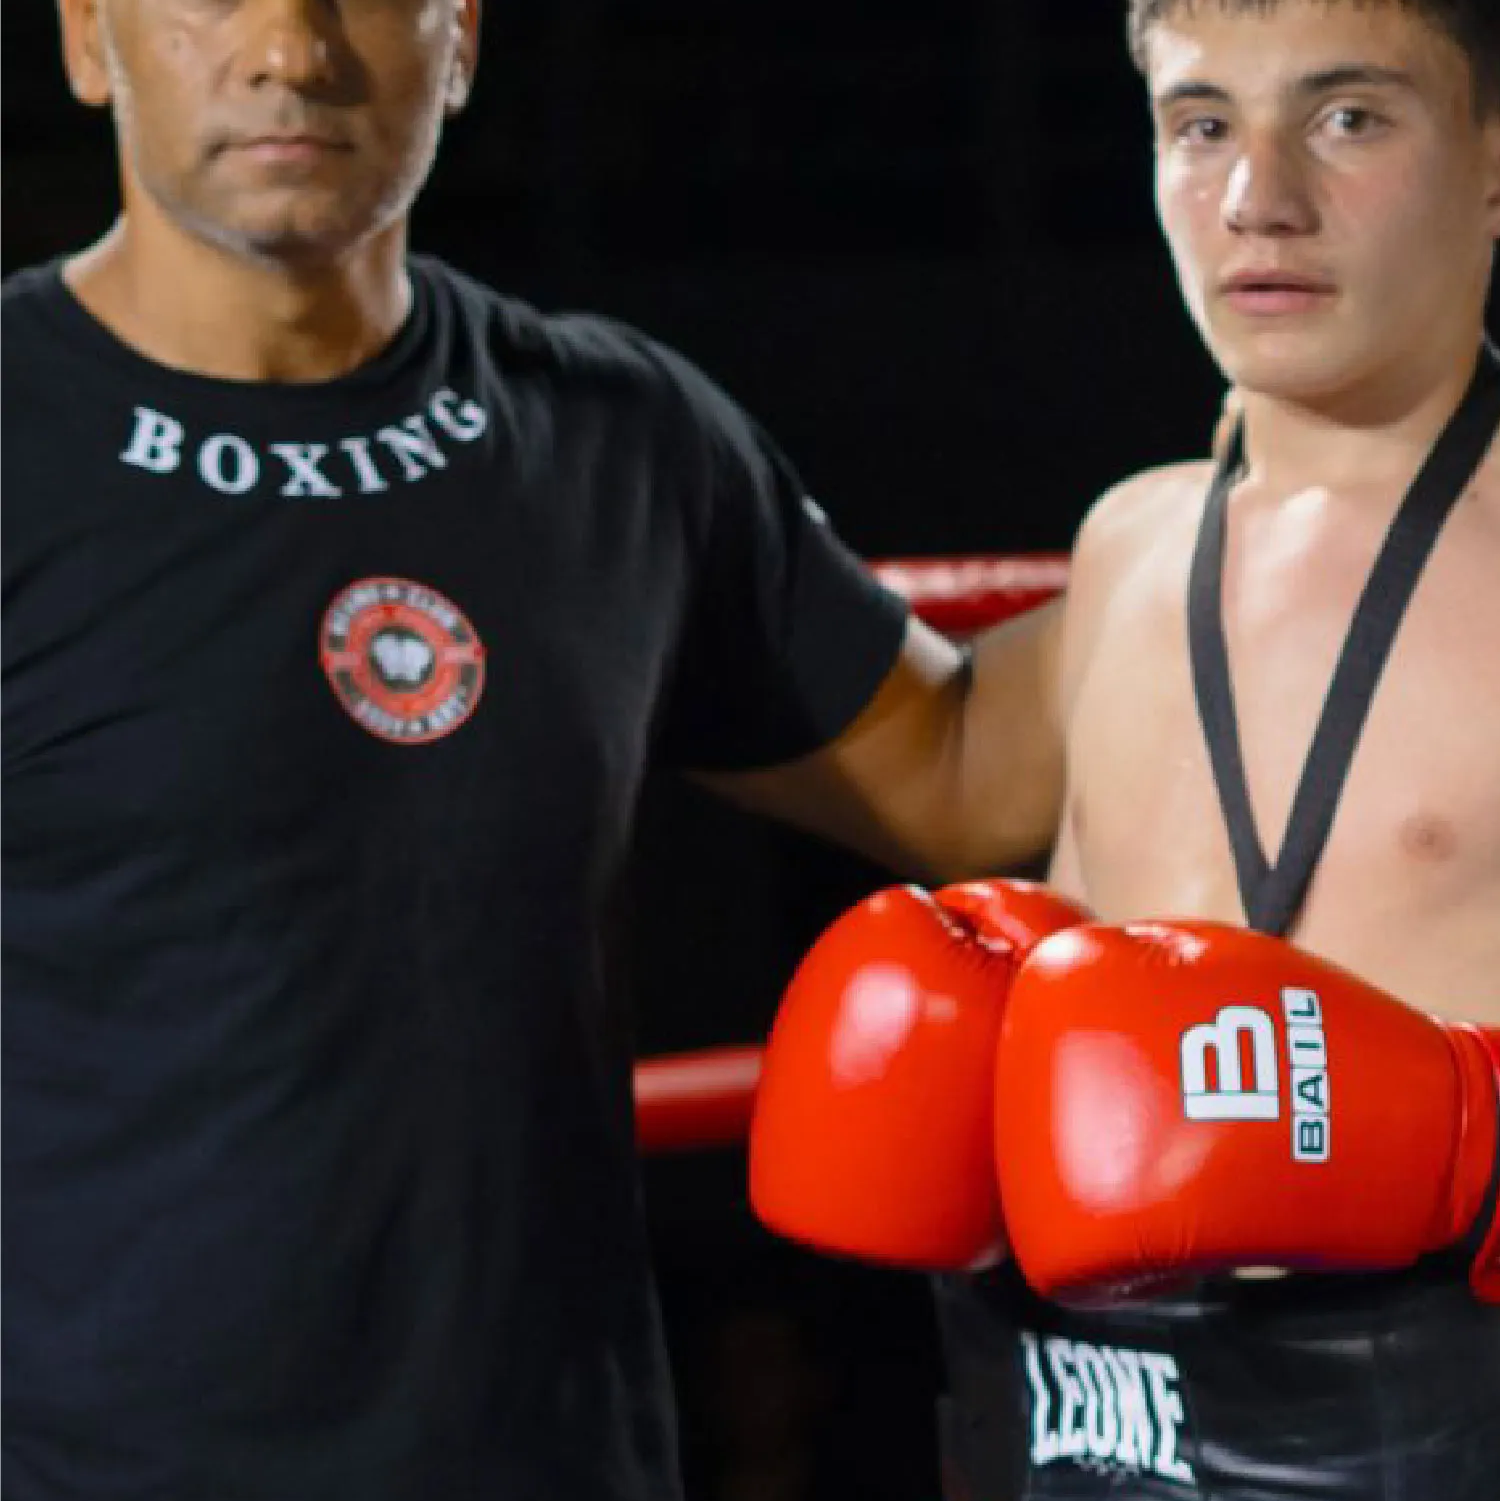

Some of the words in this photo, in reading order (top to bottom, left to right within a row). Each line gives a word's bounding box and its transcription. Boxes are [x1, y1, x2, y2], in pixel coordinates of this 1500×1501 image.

[119, 386, 489, 498] BOXING
[1286, 993, 1328, 1159] BAIL
[1019, 1330, 1195, 1484] LEONE
